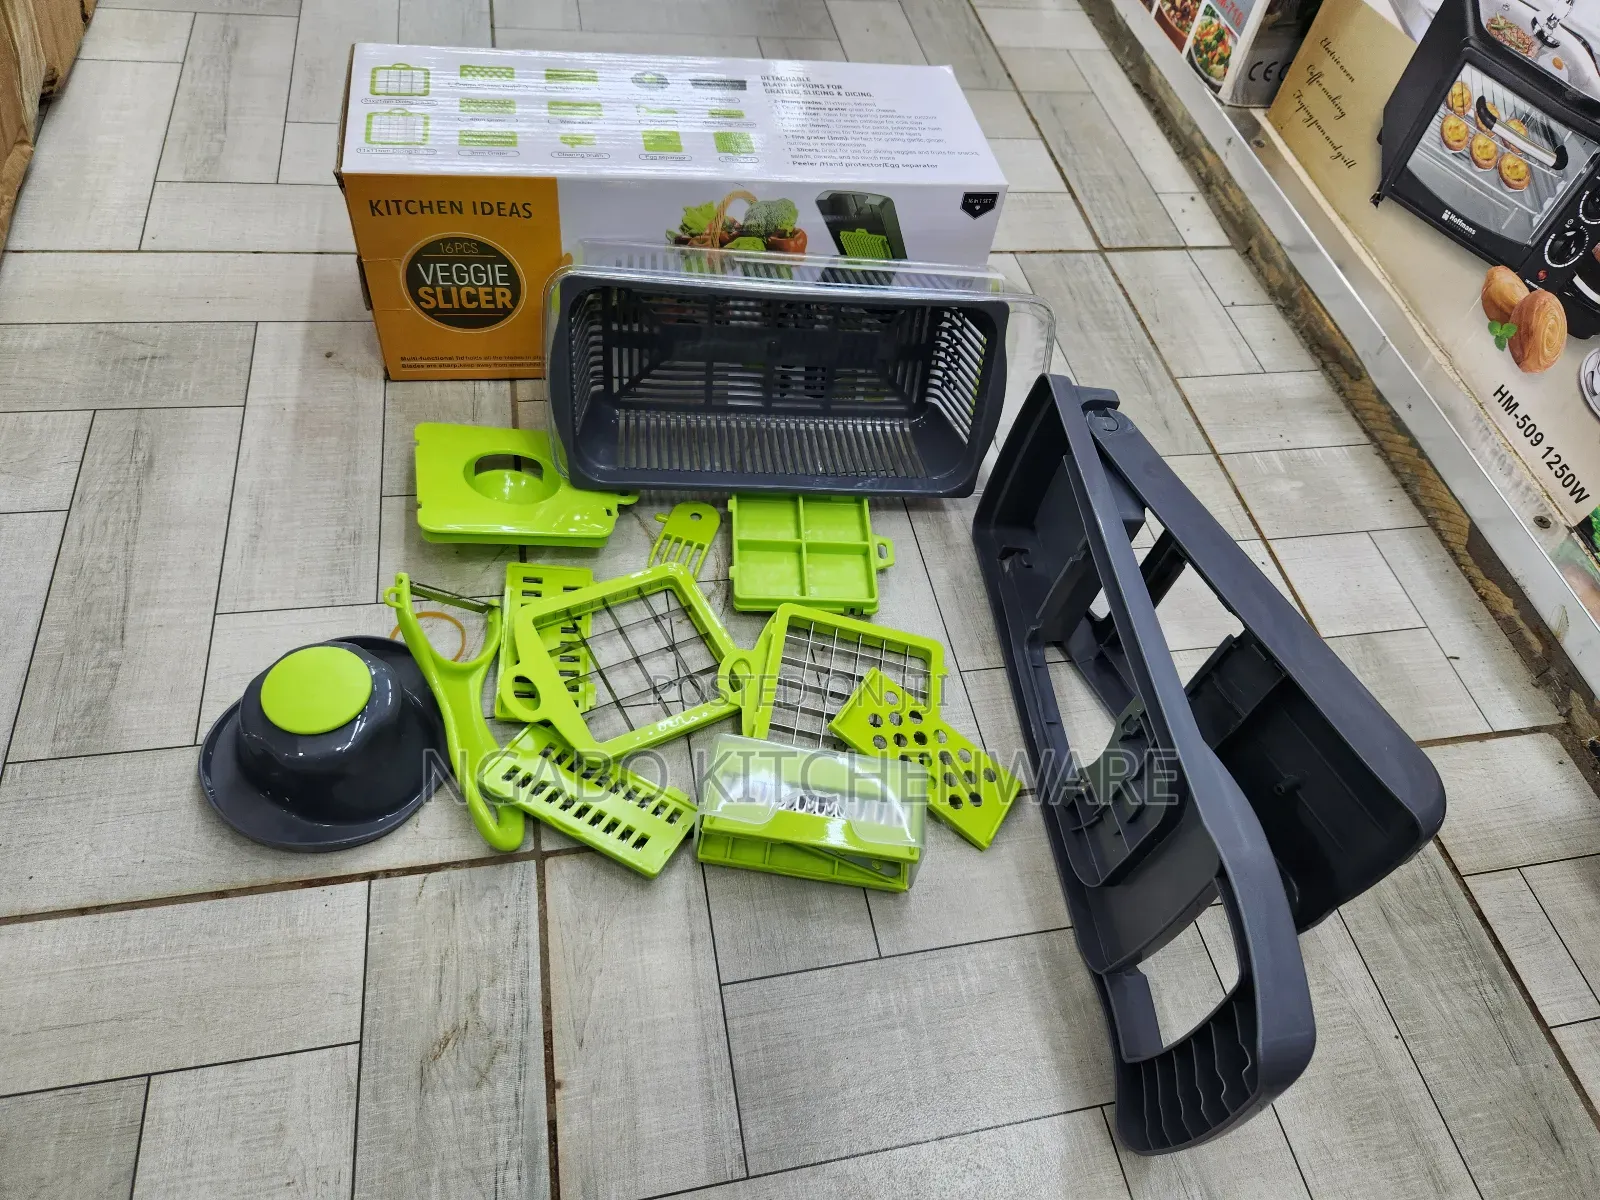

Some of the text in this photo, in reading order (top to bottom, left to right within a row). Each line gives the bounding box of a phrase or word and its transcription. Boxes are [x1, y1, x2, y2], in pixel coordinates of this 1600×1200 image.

[1320, 37, 1355, 83] Electric oven
[1306, 64, 1346, 120] Coffee making
[1292, 89, 1357, 169] Frying pan and grill
[368, 199, 533, 219] KITCHEN IDEAS
[1449, 213, 1477, 236] Hoffmans
[440, 242, 480, 254] 16PCS
[417, 263, 511, 286] VEGGIE
[418, 286, 514, 310] SLICER
[1492, 384, 1590, 504] HM-509 1250W
